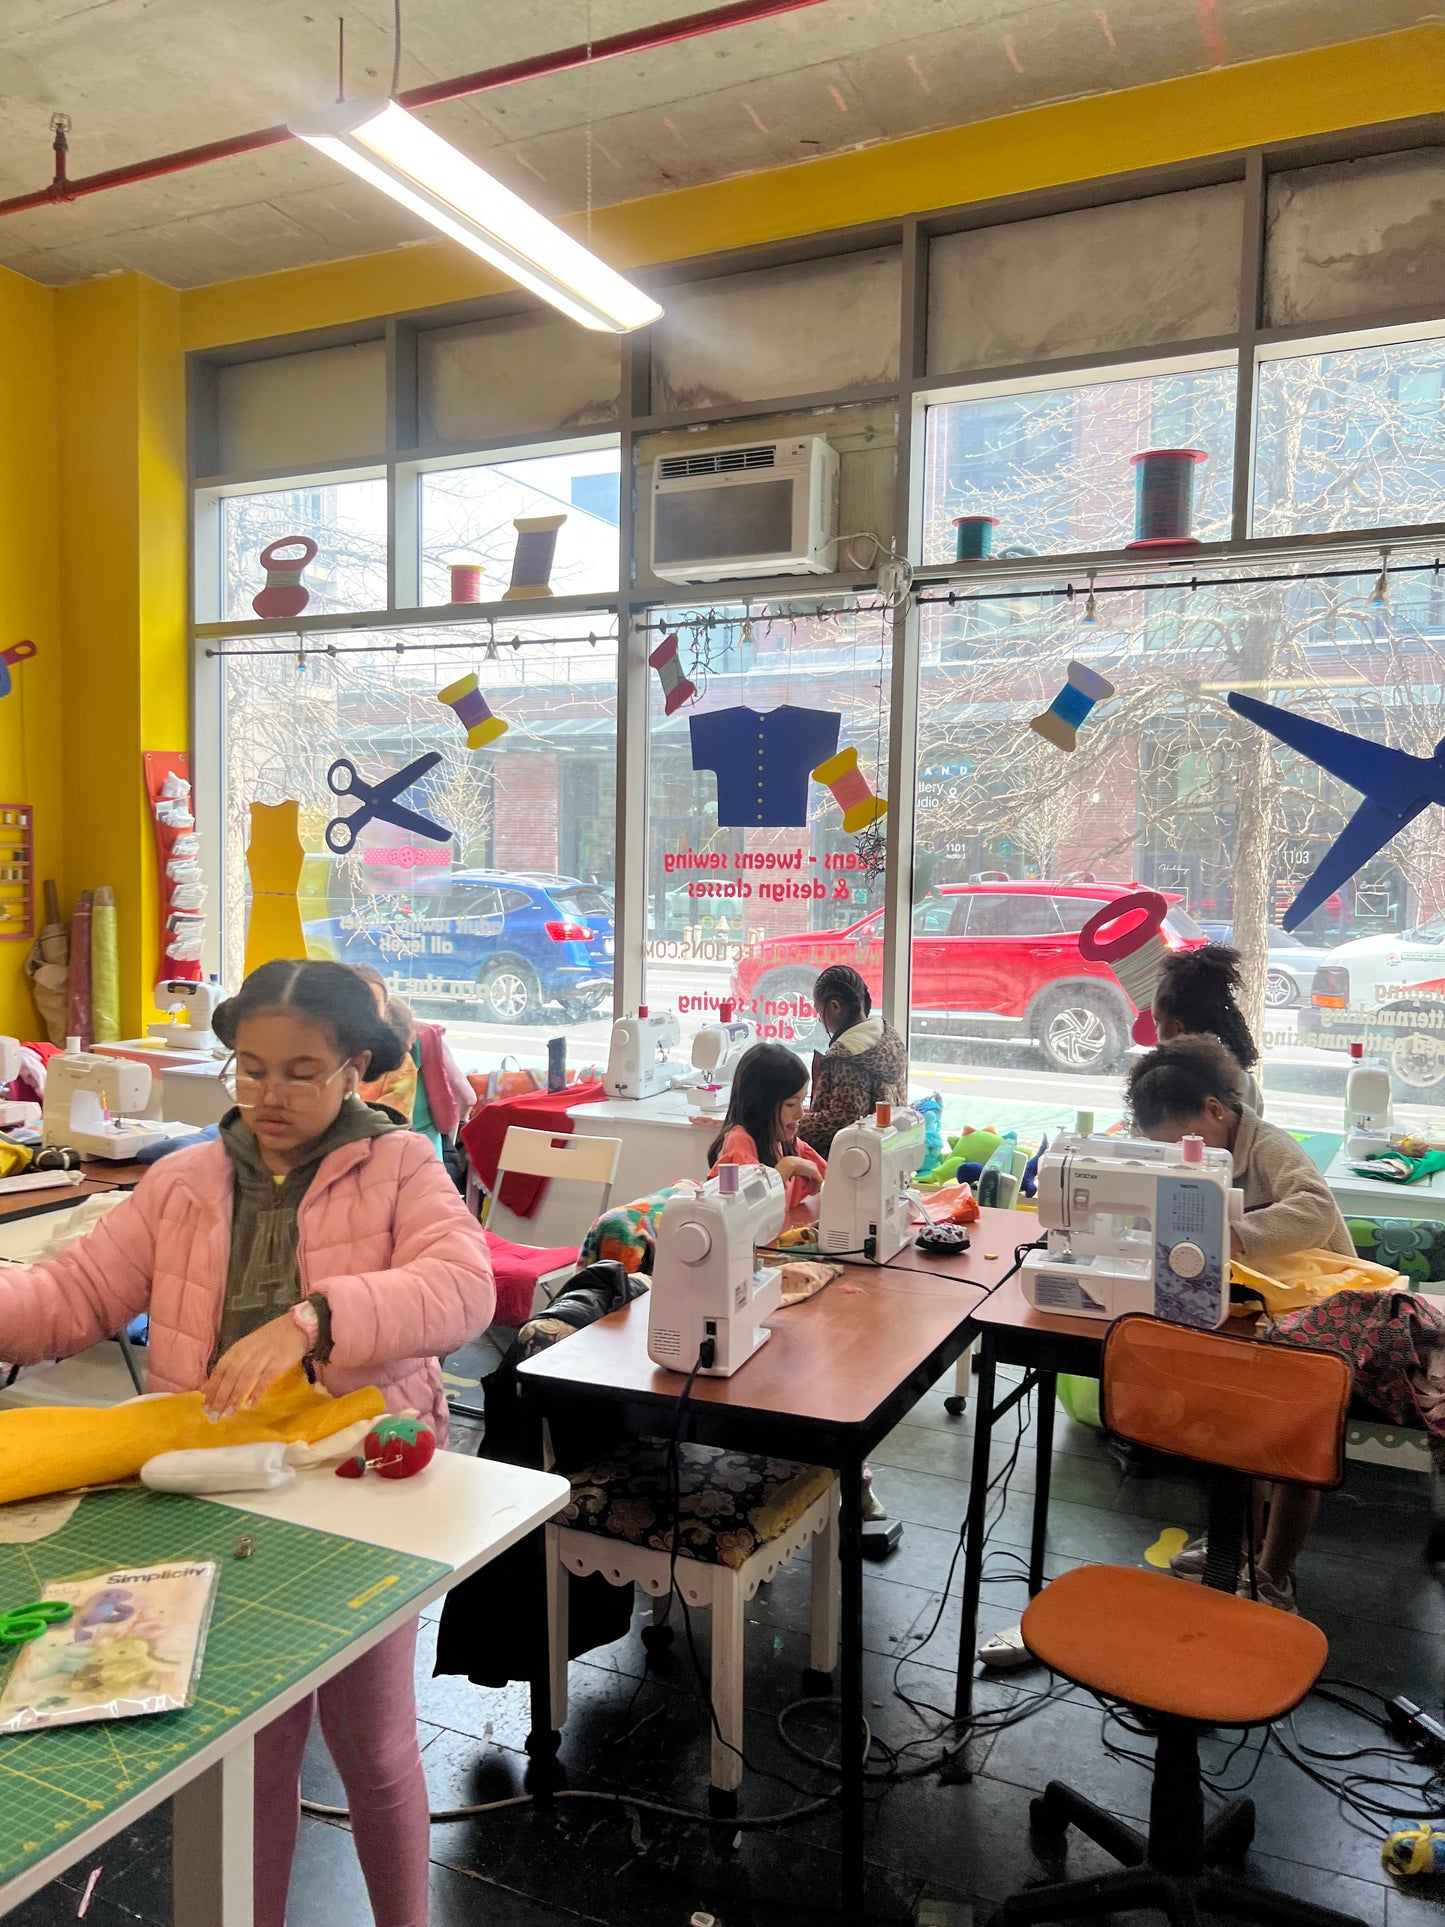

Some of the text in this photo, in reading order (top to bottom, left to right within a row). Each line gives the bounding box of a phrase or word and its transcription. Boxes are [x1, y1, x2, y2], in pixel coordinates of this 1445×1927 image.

[945, 843, 966, 853] 1101
[1284, 850, 1310, 865] 1103
[105, 1567, 207, 1585] Simplicity
